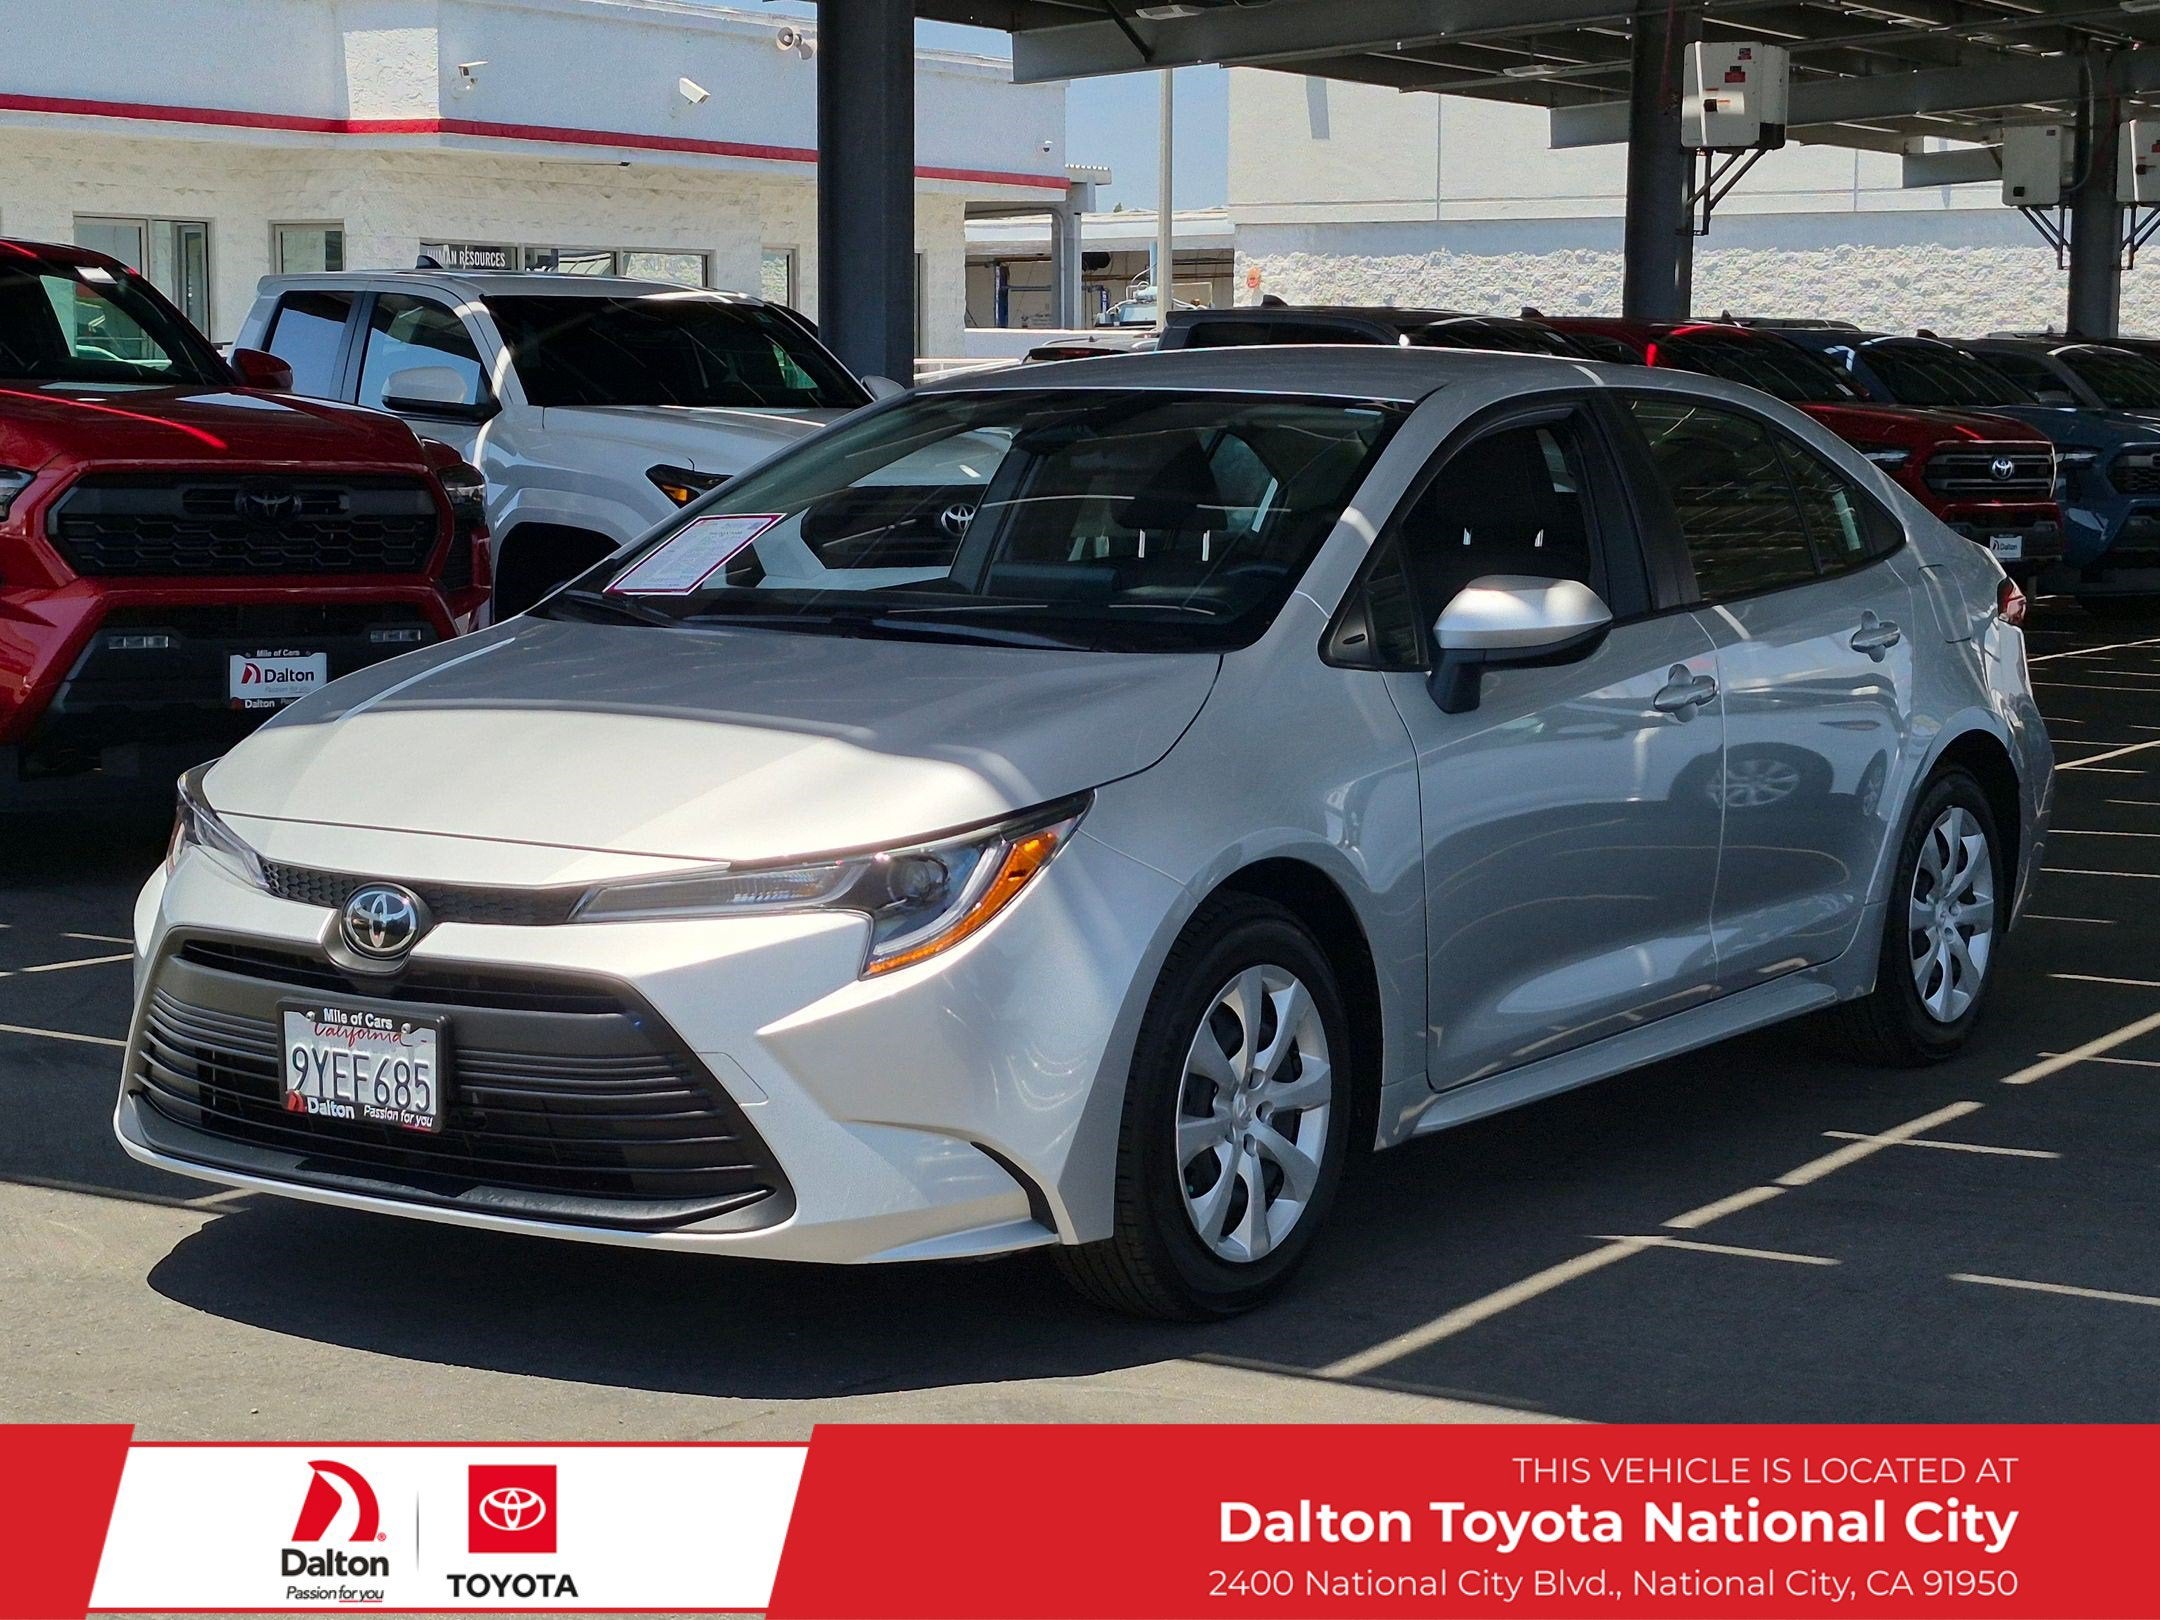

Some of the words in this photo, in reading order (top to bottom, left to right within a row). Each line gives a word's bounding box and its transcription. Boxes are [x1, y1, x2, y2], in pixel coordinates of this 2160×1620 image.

[459, 250, 506, 267] RESOURCES
[264, 667, 315, 683] Dalton
[244, 699, 275, 709] Dalton
[323, 1007, 348, 1024] Mile
[350, 1011, 363, 1026] of
[364, 1015, 393, 1030] Cars
[314, 1021, 413, 1048] California
[291, 1045, 431, 1112] 9YEF685
[306, 1096, 356, 1120] Dalton
[363, 1104, 399, 1122] Passion
[400, 1108, 416, 1124] for
[415, 1114, 434, 1128] you
